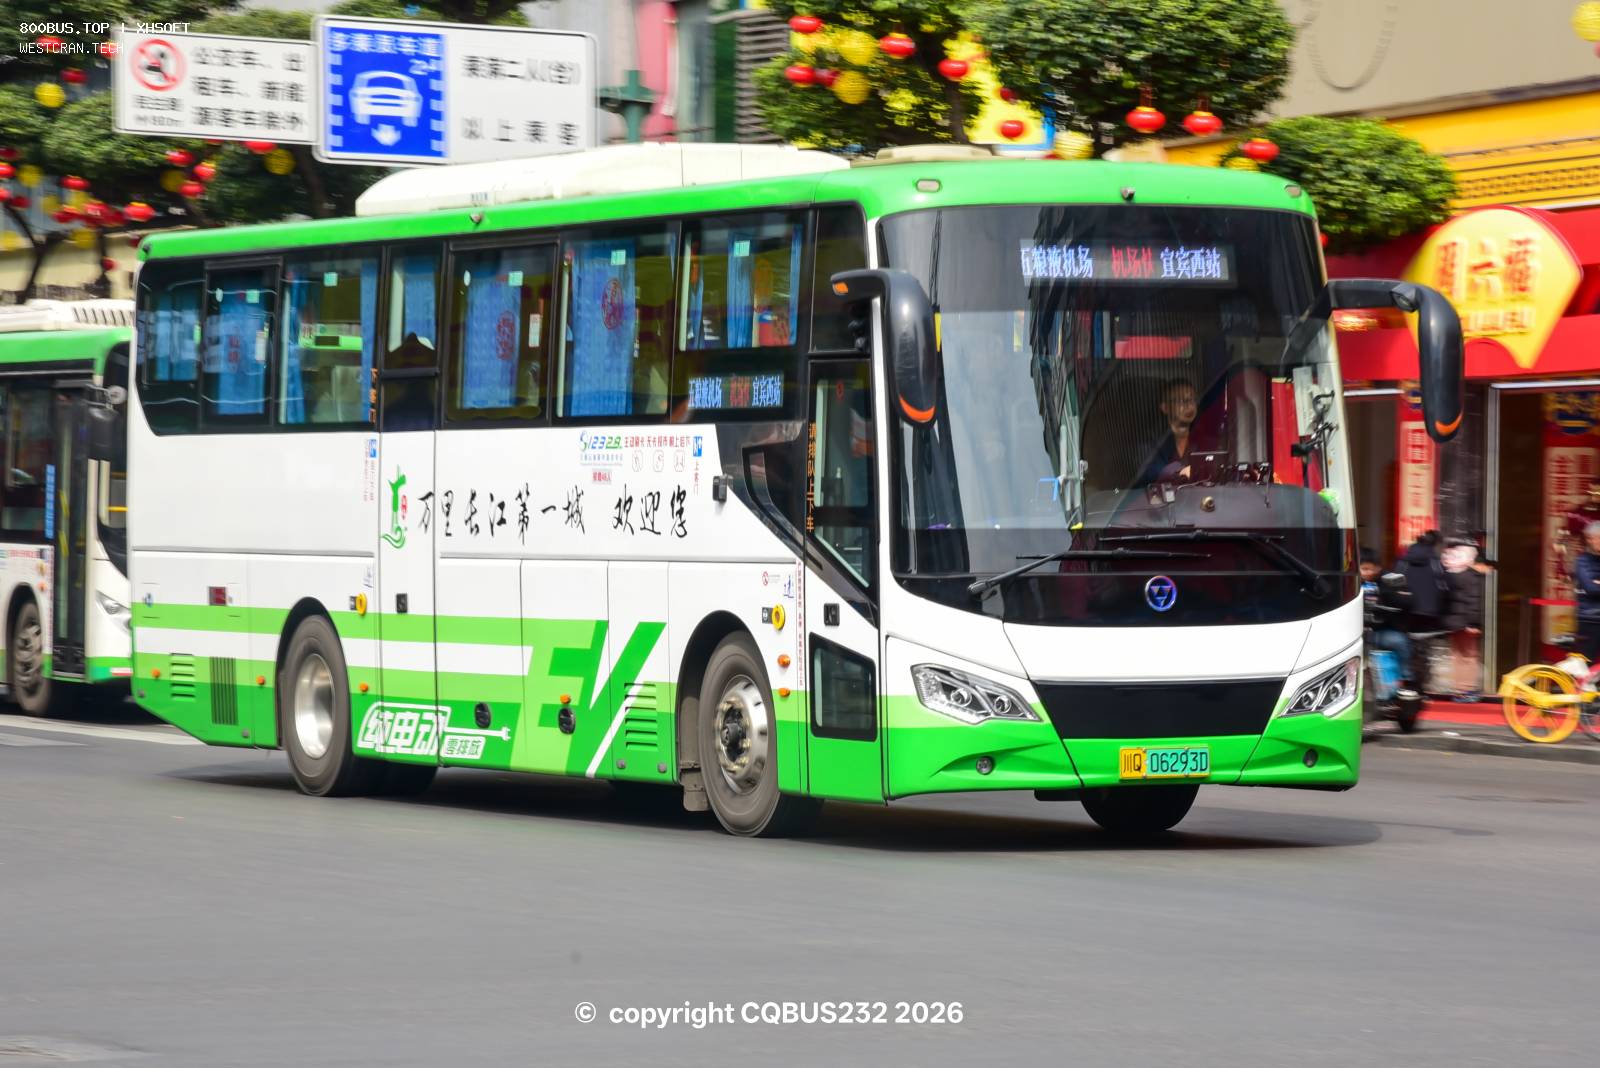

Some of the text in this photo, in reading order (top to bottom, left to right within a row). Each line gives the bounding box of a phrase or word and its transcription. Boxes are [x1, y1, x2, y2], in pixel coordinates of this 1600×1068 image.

[1160, 245, 1221, 279] 宜宾西站
[751, 375, 782, 408] 宜宾西站
[418, 482, 585, 545] 万里长江第一城
[613, 483, 688, 538] 欢迎您
[363, 709, 446, 755] 纯电动
